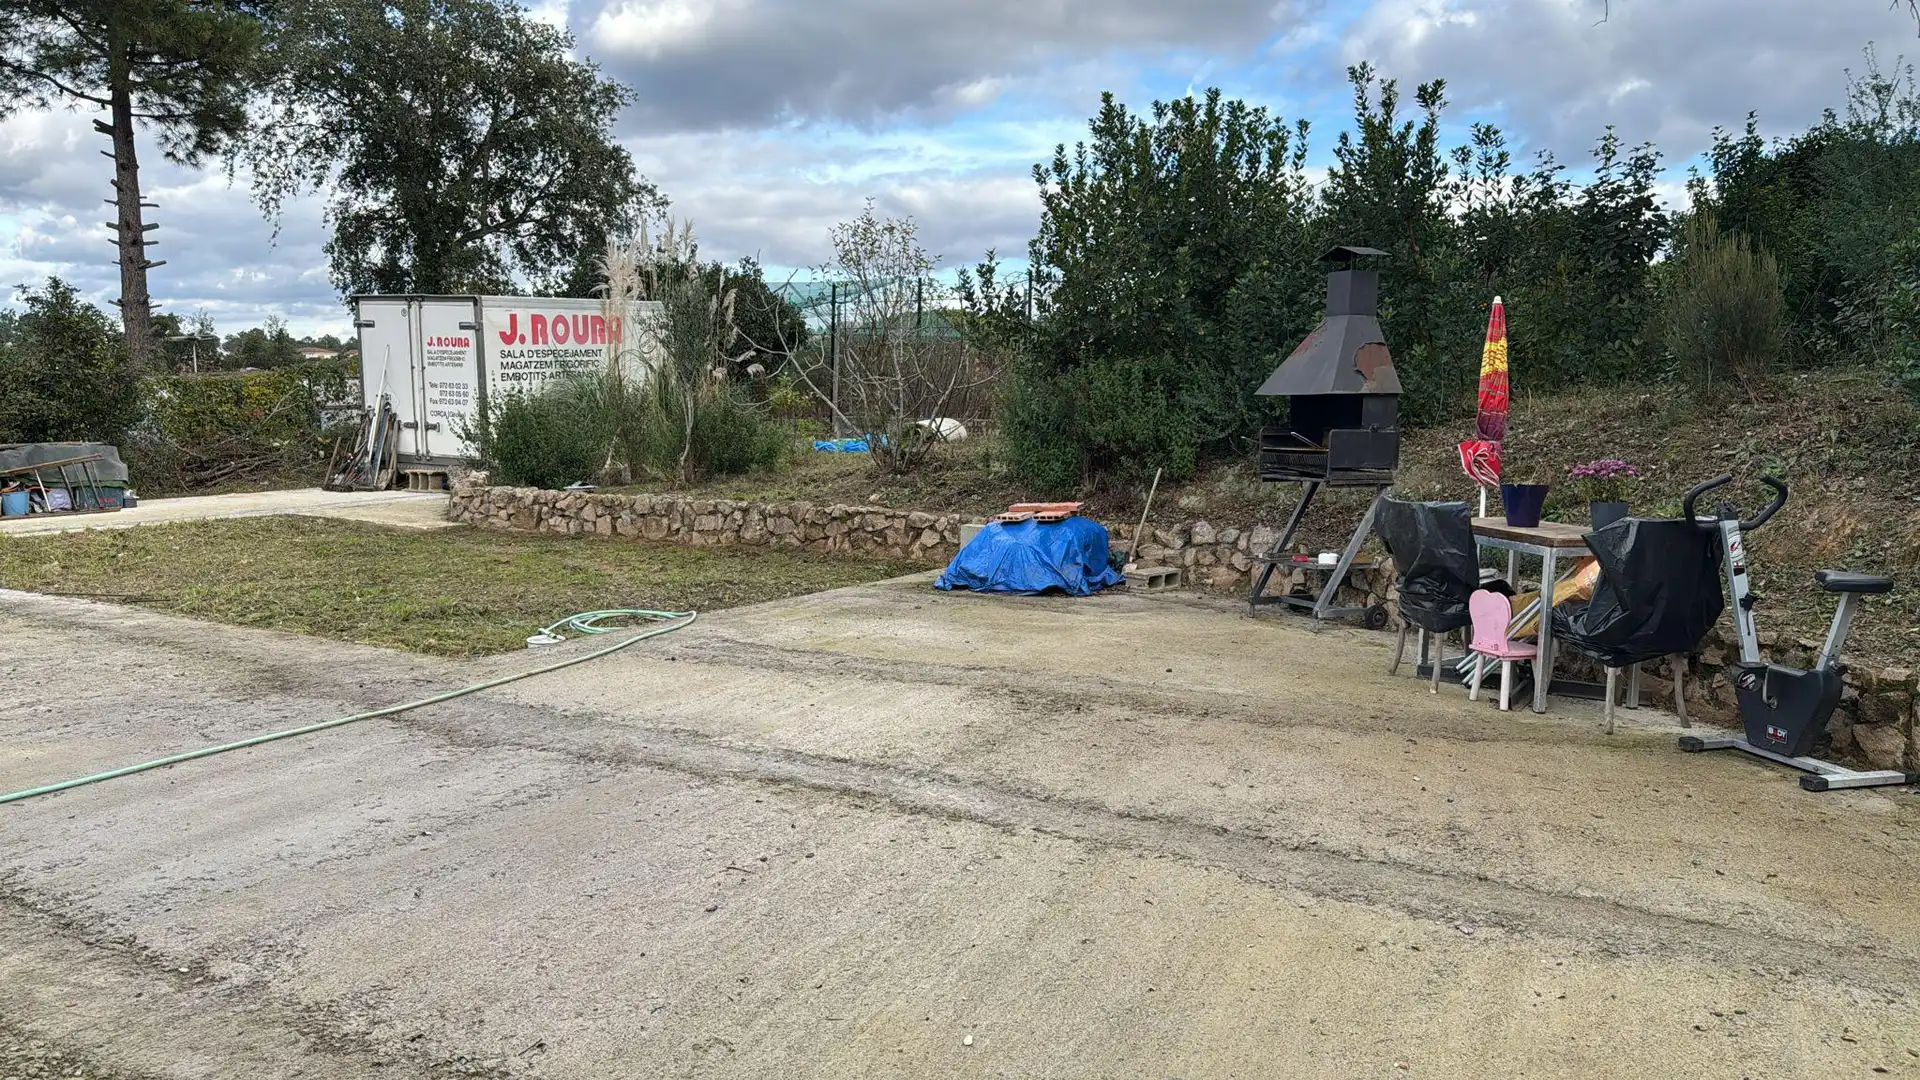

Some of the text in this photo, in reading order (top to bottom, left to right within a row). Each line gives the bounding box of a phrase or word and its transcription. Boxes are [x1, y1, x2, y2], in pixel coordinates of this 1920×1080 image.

[427, 336, 470, 348] J.ROURA
[500, 349, 526, 359] SALA
[500, 360, 554, 370] MAGATZEM
[501, 371, 547, 382] EMBOTITS
